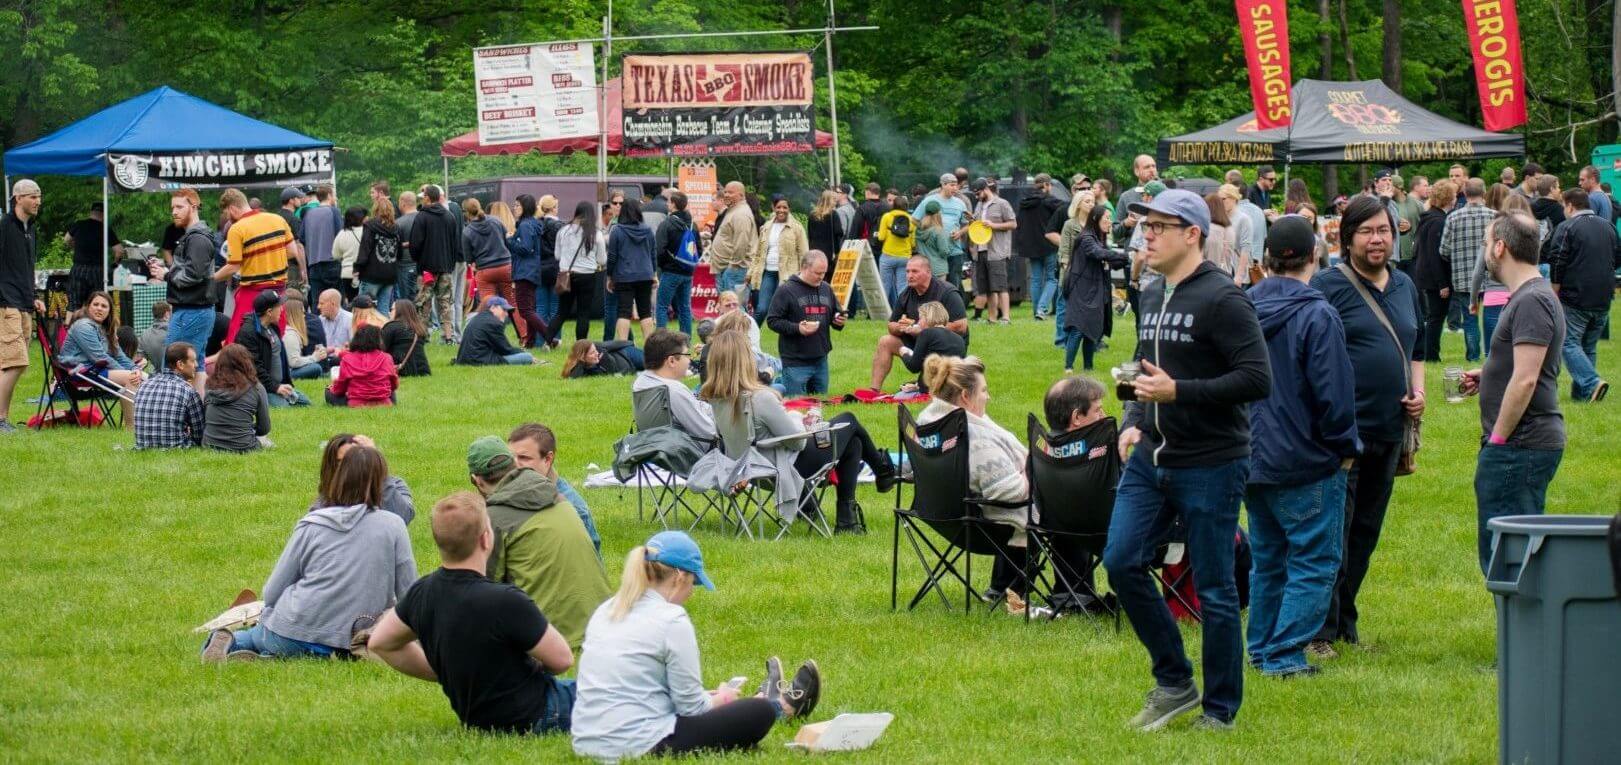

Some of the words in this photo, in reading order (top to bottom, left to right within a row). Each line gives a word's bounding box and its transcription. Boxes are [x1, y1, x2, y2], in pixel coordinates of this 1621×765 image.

[1250, 3, 1291, 121] SAUSAGES
[1472, 0, 1514, 107] EROGIS
[631, 64, 694, 103] TEXAS
[703, 73, 734, 95] BBQ
[744, 62, 806, 101] SMOKE
[624, 116, 672, 143] Championship
[676, 115, 708, 136] Barbecue
[711, 114, 731, 136] Team
[734, 115, 741, 134] &
[743, 113, 773, 141] Catering
[776, 112, 811, 139] Specialists
[1332, 103, 1393, 124] BBQ
[158, 154, 246, 178] KIMCHI
[255, 150, 331, 175] SMOKE
[1344, 142, 1394, 162] AUTHENTIC
[1048, 439, 1083, 458] ASCAR
